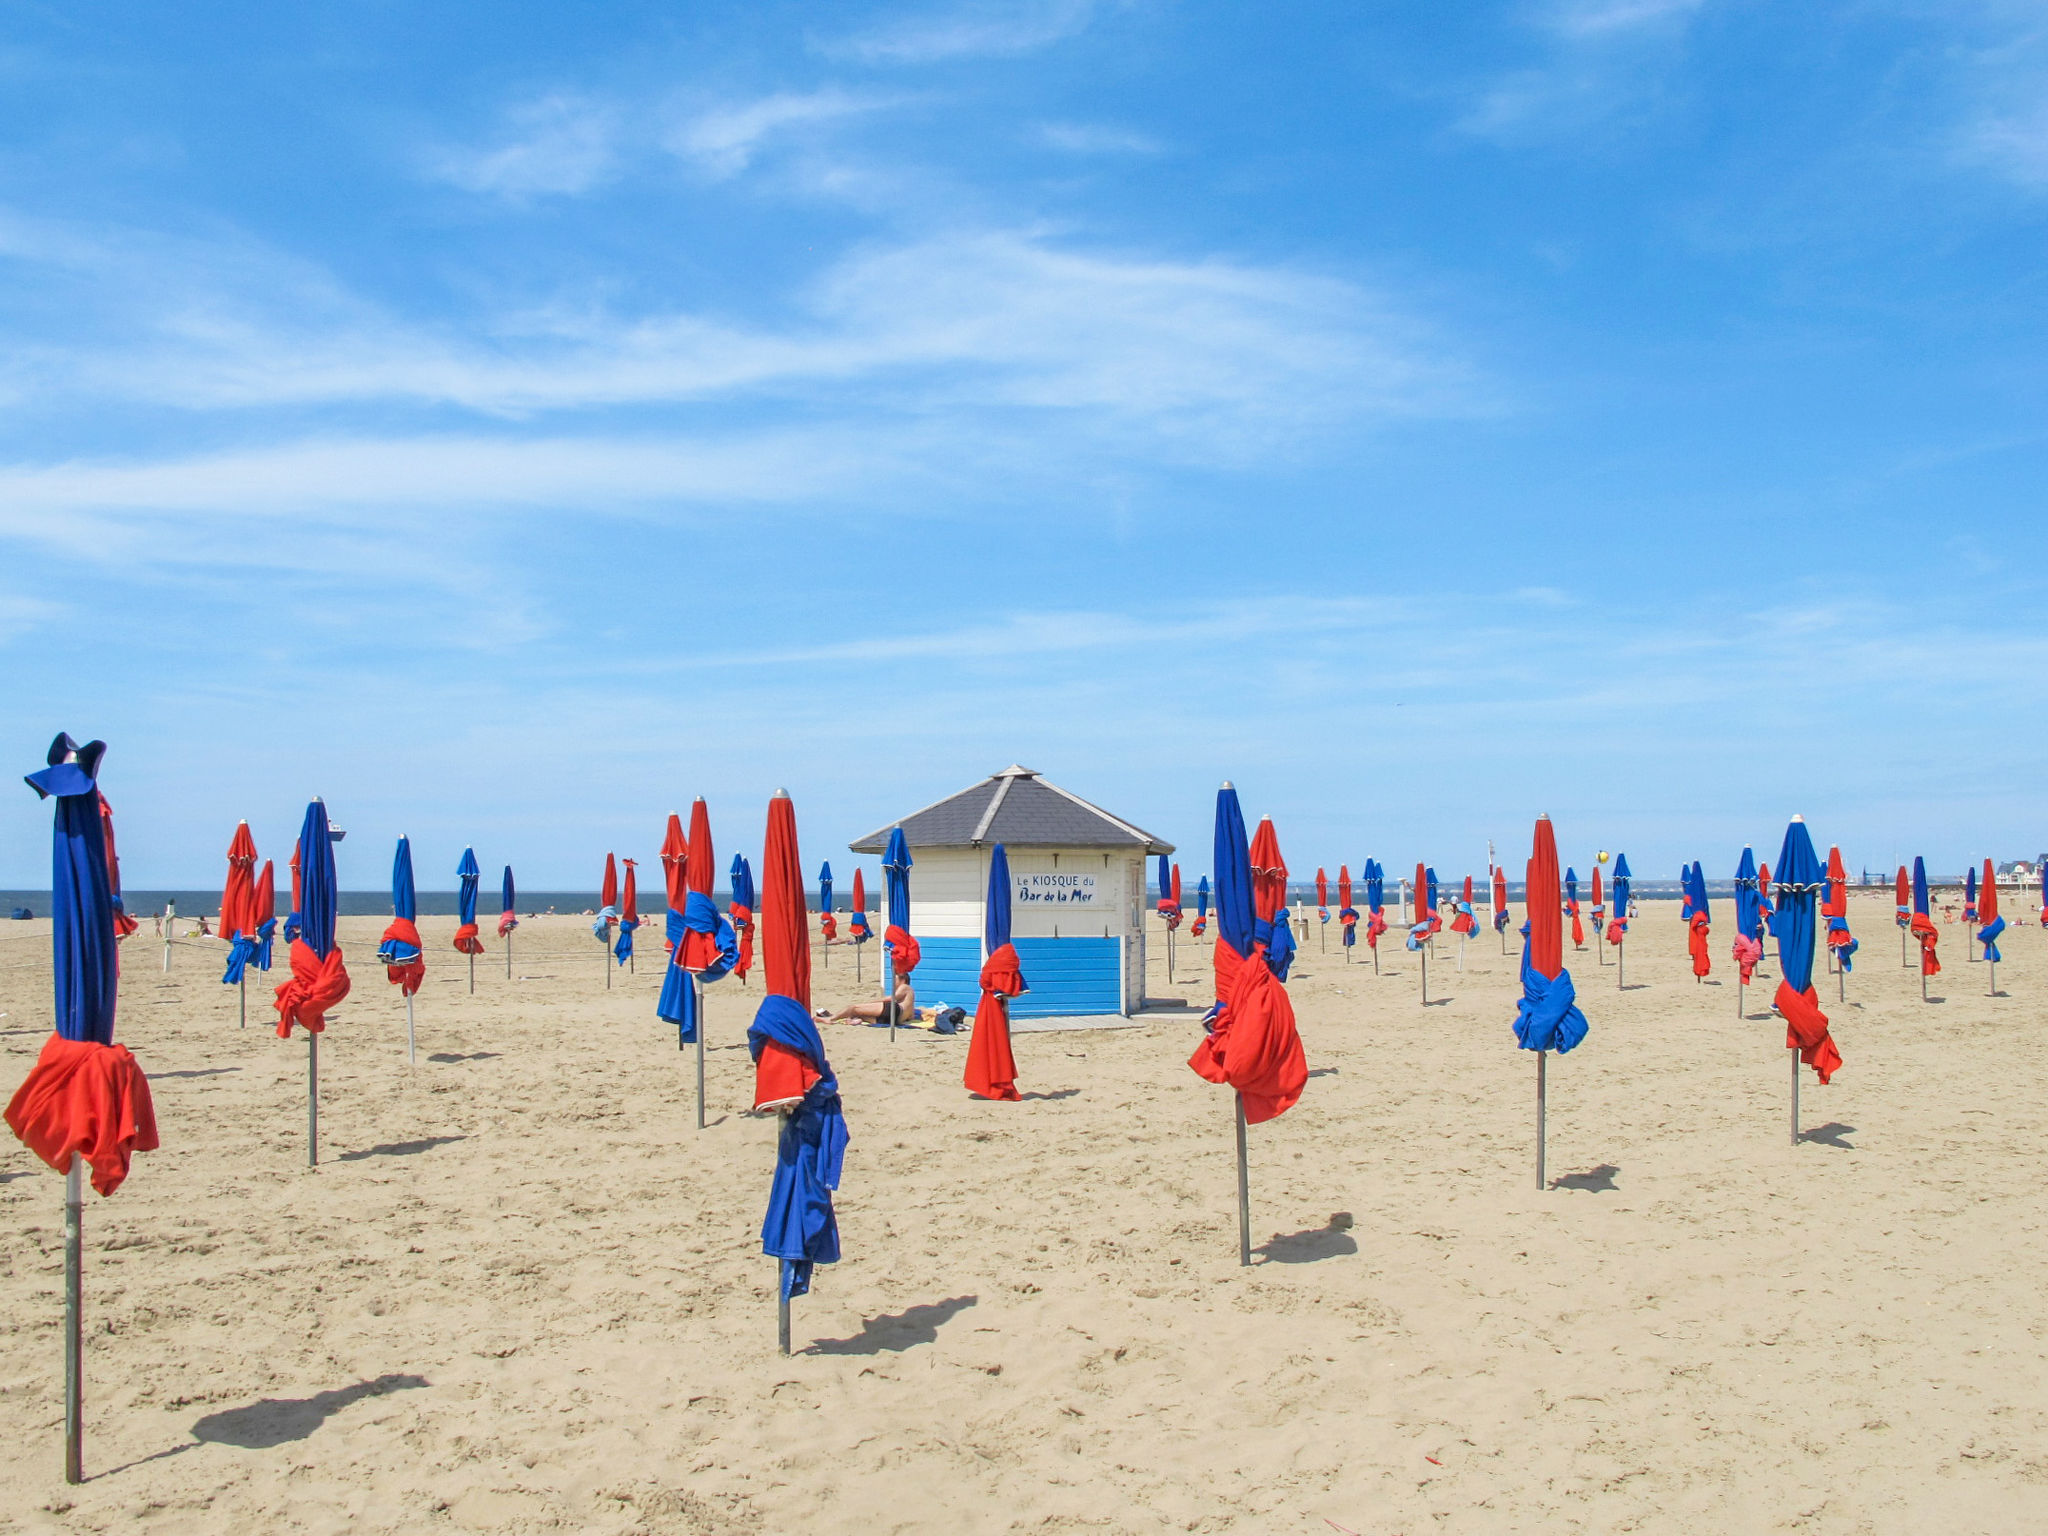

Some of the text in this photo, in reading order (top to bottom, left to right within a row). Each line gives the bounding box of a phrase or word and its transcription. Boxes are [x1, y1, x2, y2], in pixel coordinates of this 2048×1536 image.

[1017, 876, 1094, 887] Le KIOSQUE du
[1020, 887, 1092, 902] Bar de la Mer
